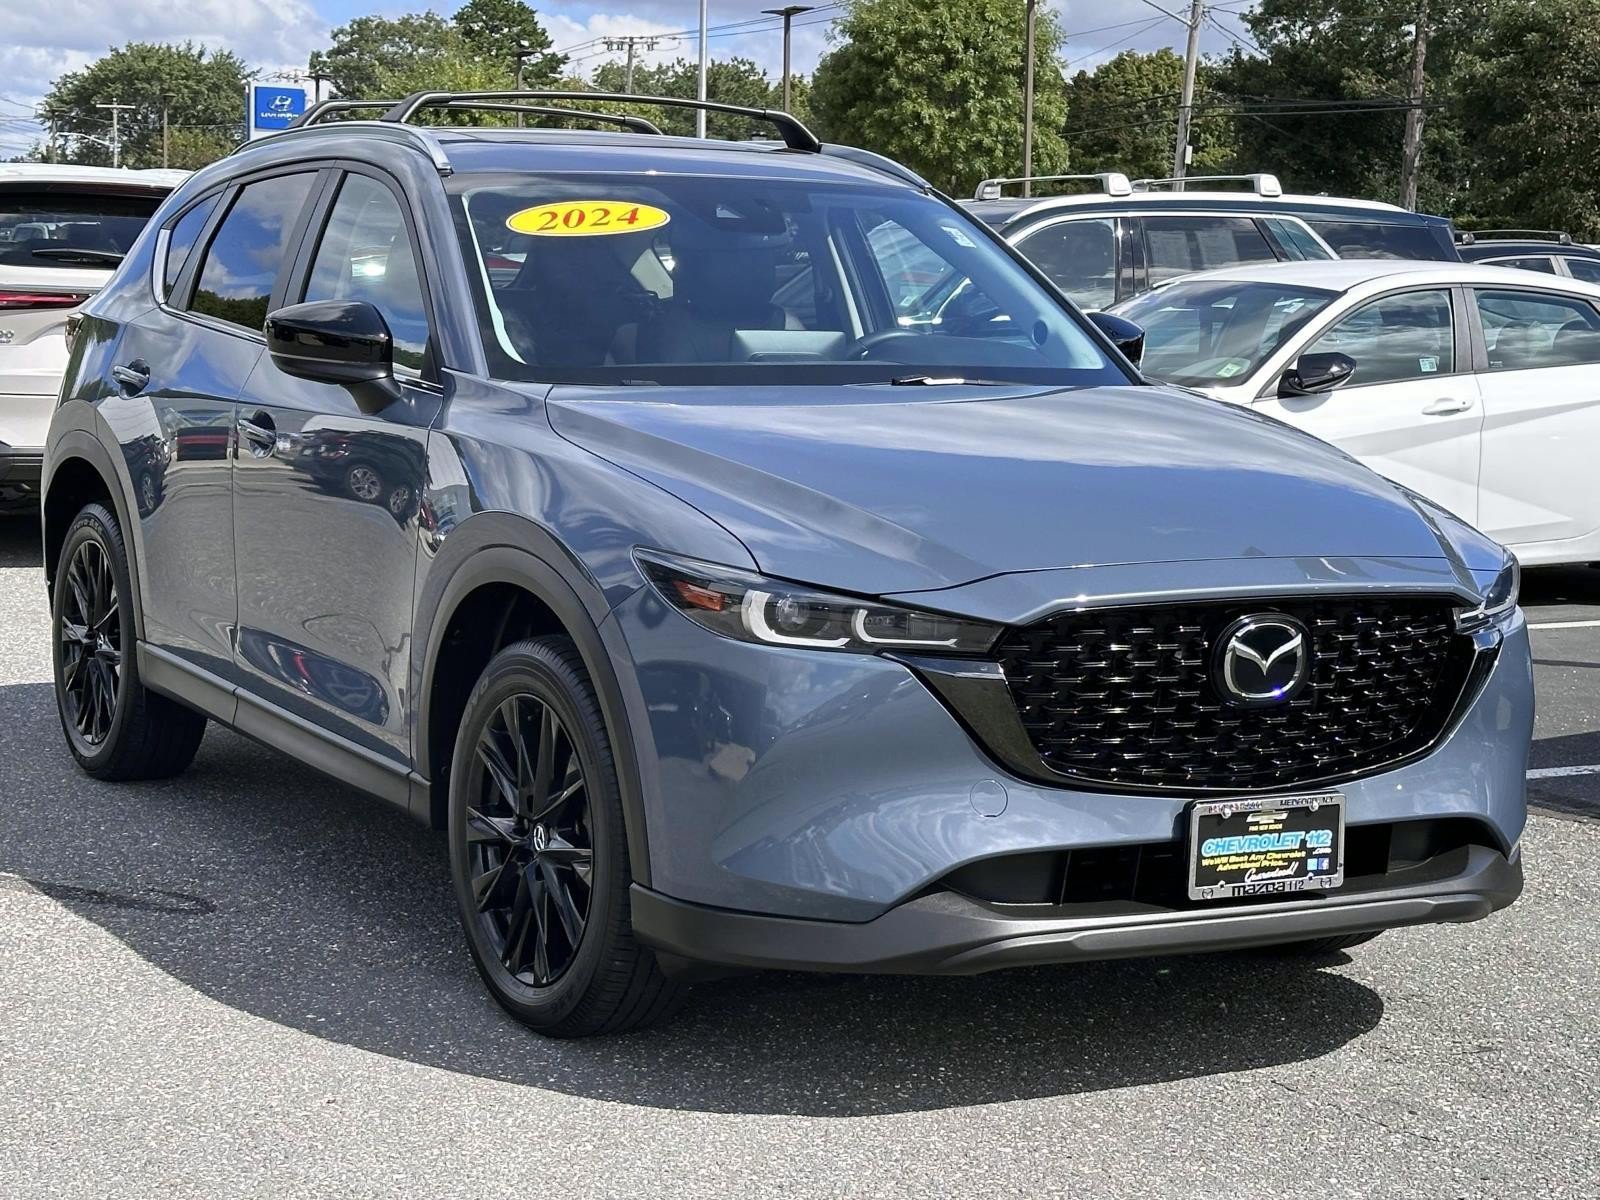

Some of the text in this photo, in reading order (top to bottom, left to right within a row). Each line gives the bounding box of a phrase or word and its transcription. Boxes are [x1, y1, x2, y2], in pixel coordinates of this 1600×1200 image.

[536, 207, 639, 232] 2024
[1201, 829, 1333, 857] CHEVROLET 112
[1231, 879, 1304, 897] mazda 112
